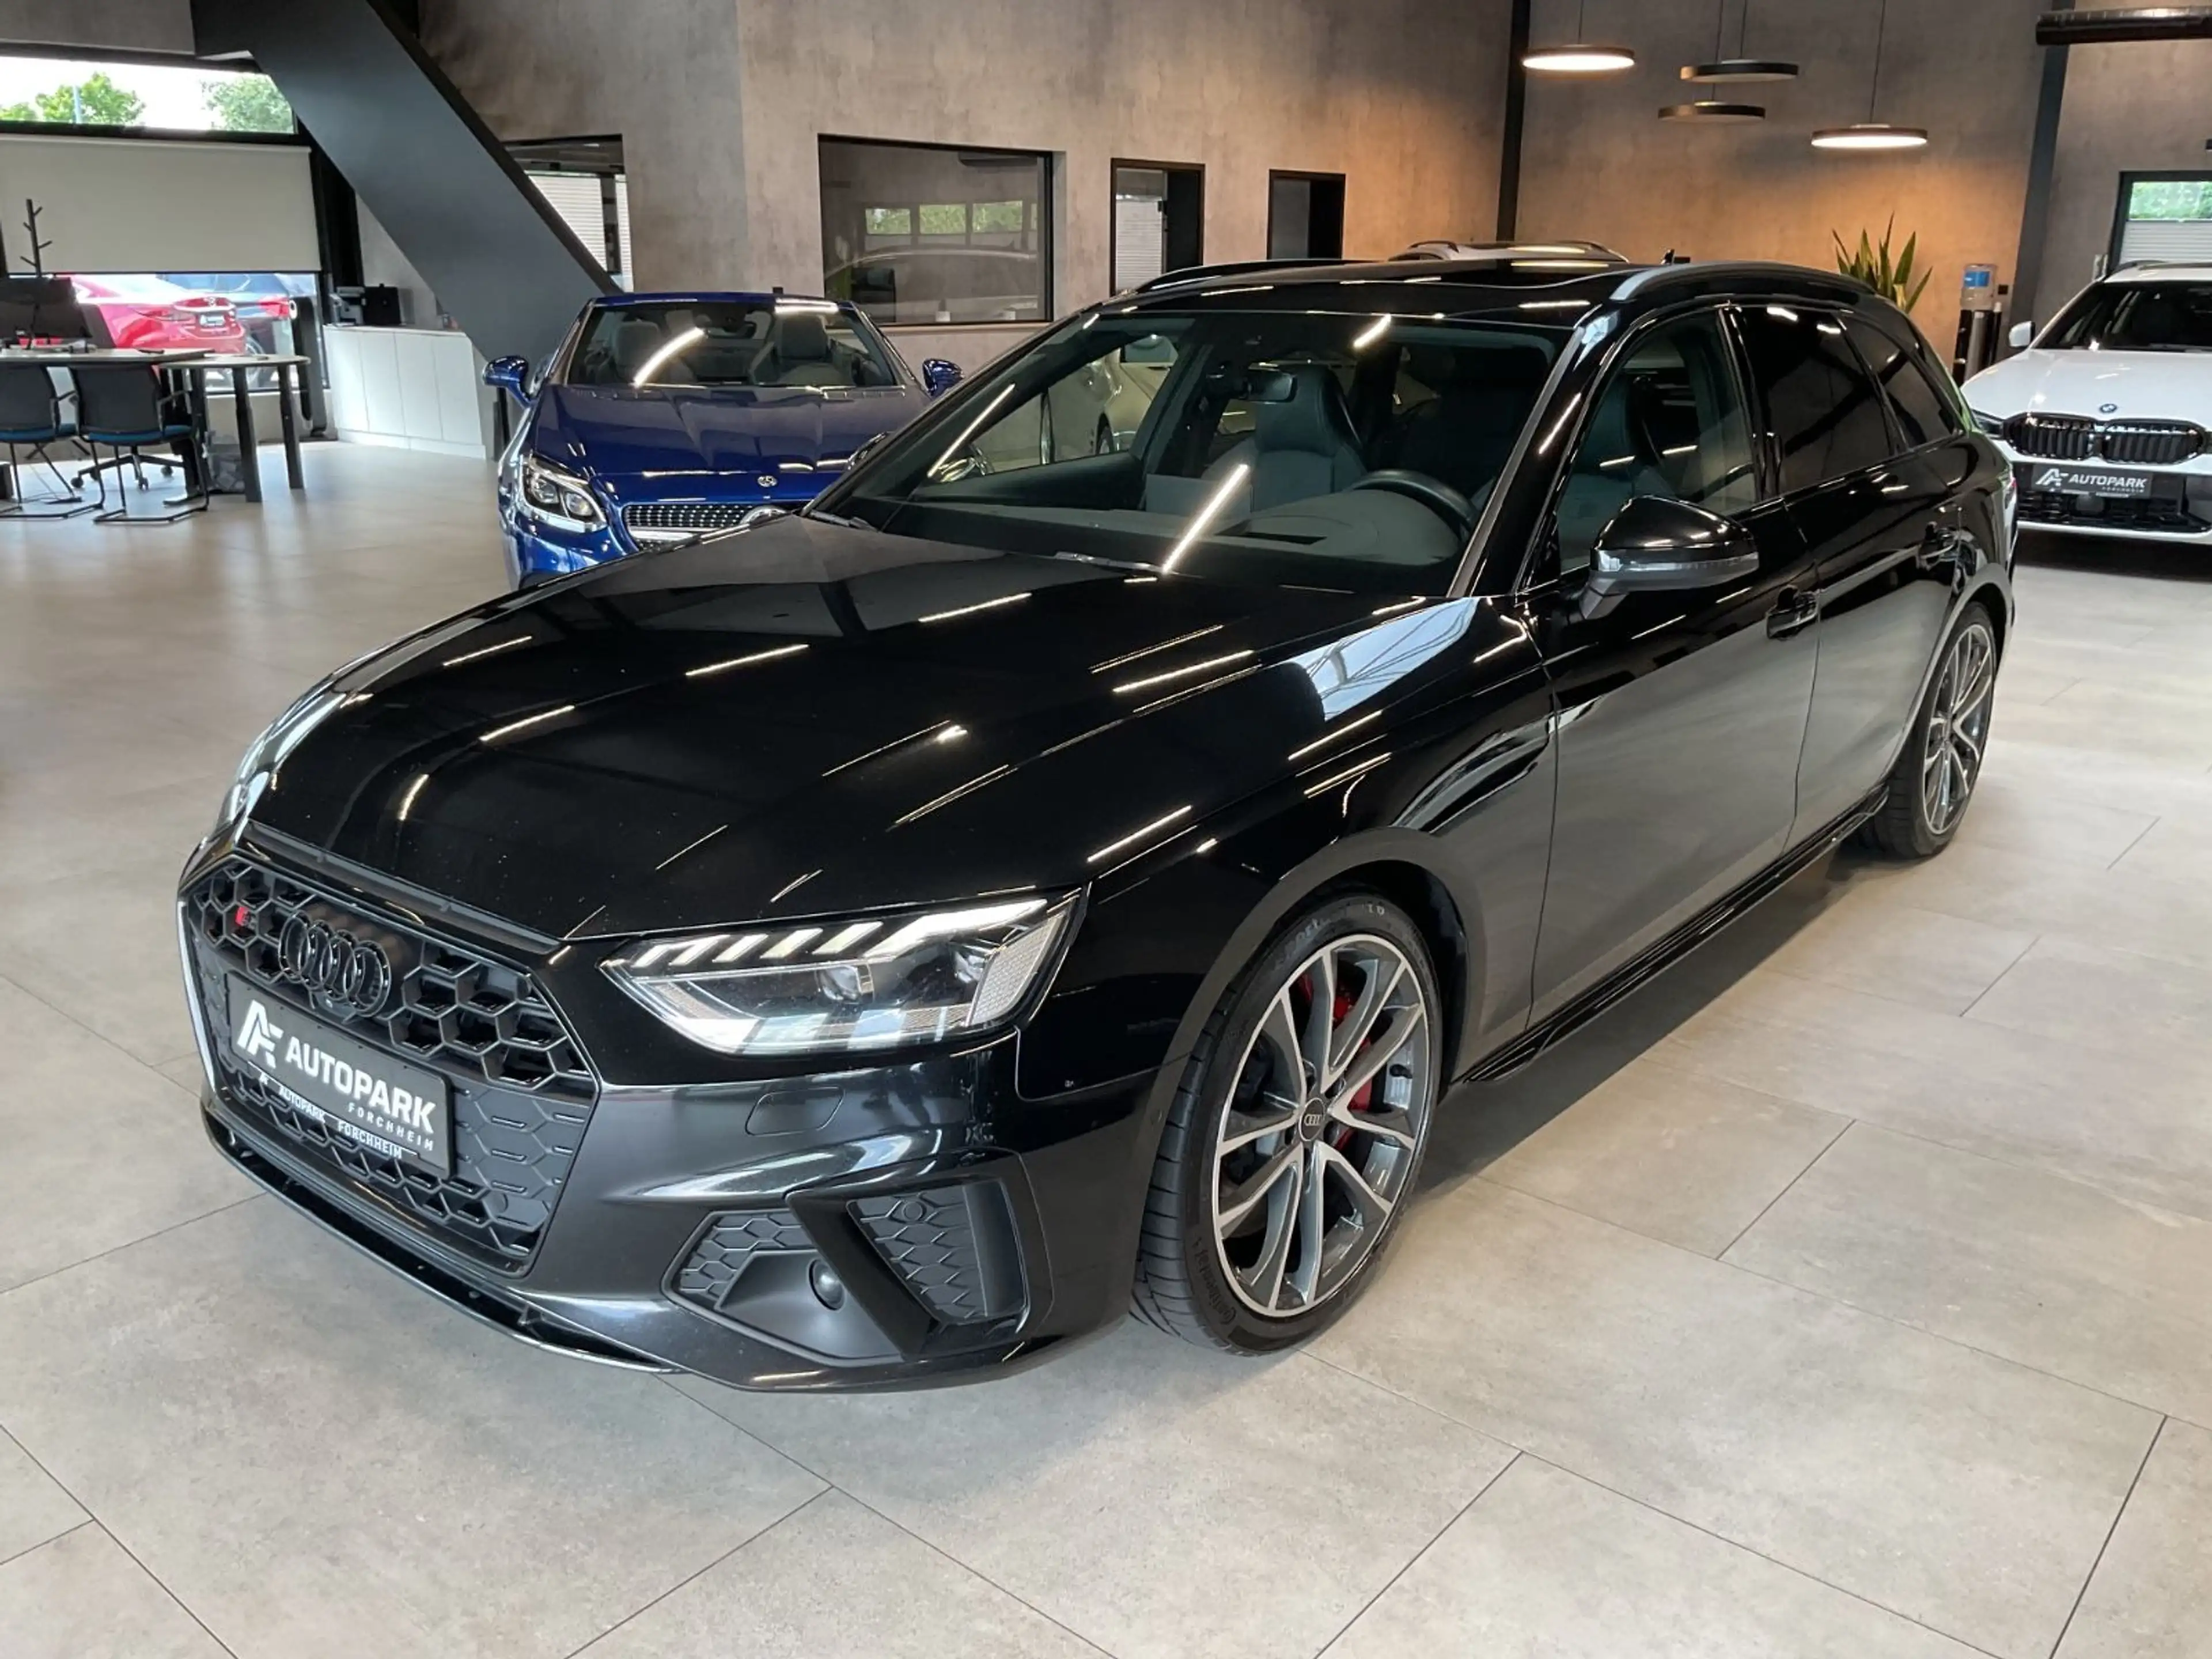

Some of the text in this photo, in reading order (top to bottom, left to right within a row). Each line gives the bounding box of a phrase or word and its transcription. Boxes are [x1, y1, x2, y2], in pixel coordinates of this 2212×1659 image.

[2069, 474, 2148, 488] AUTOPARK
[285, 1036, 436, 1134] AUTOPARK
[279, 1084, 403, 1160] AUTOPARK FORCHHEIM
[348, 1101, 434, 1152] FORCHHEIM
